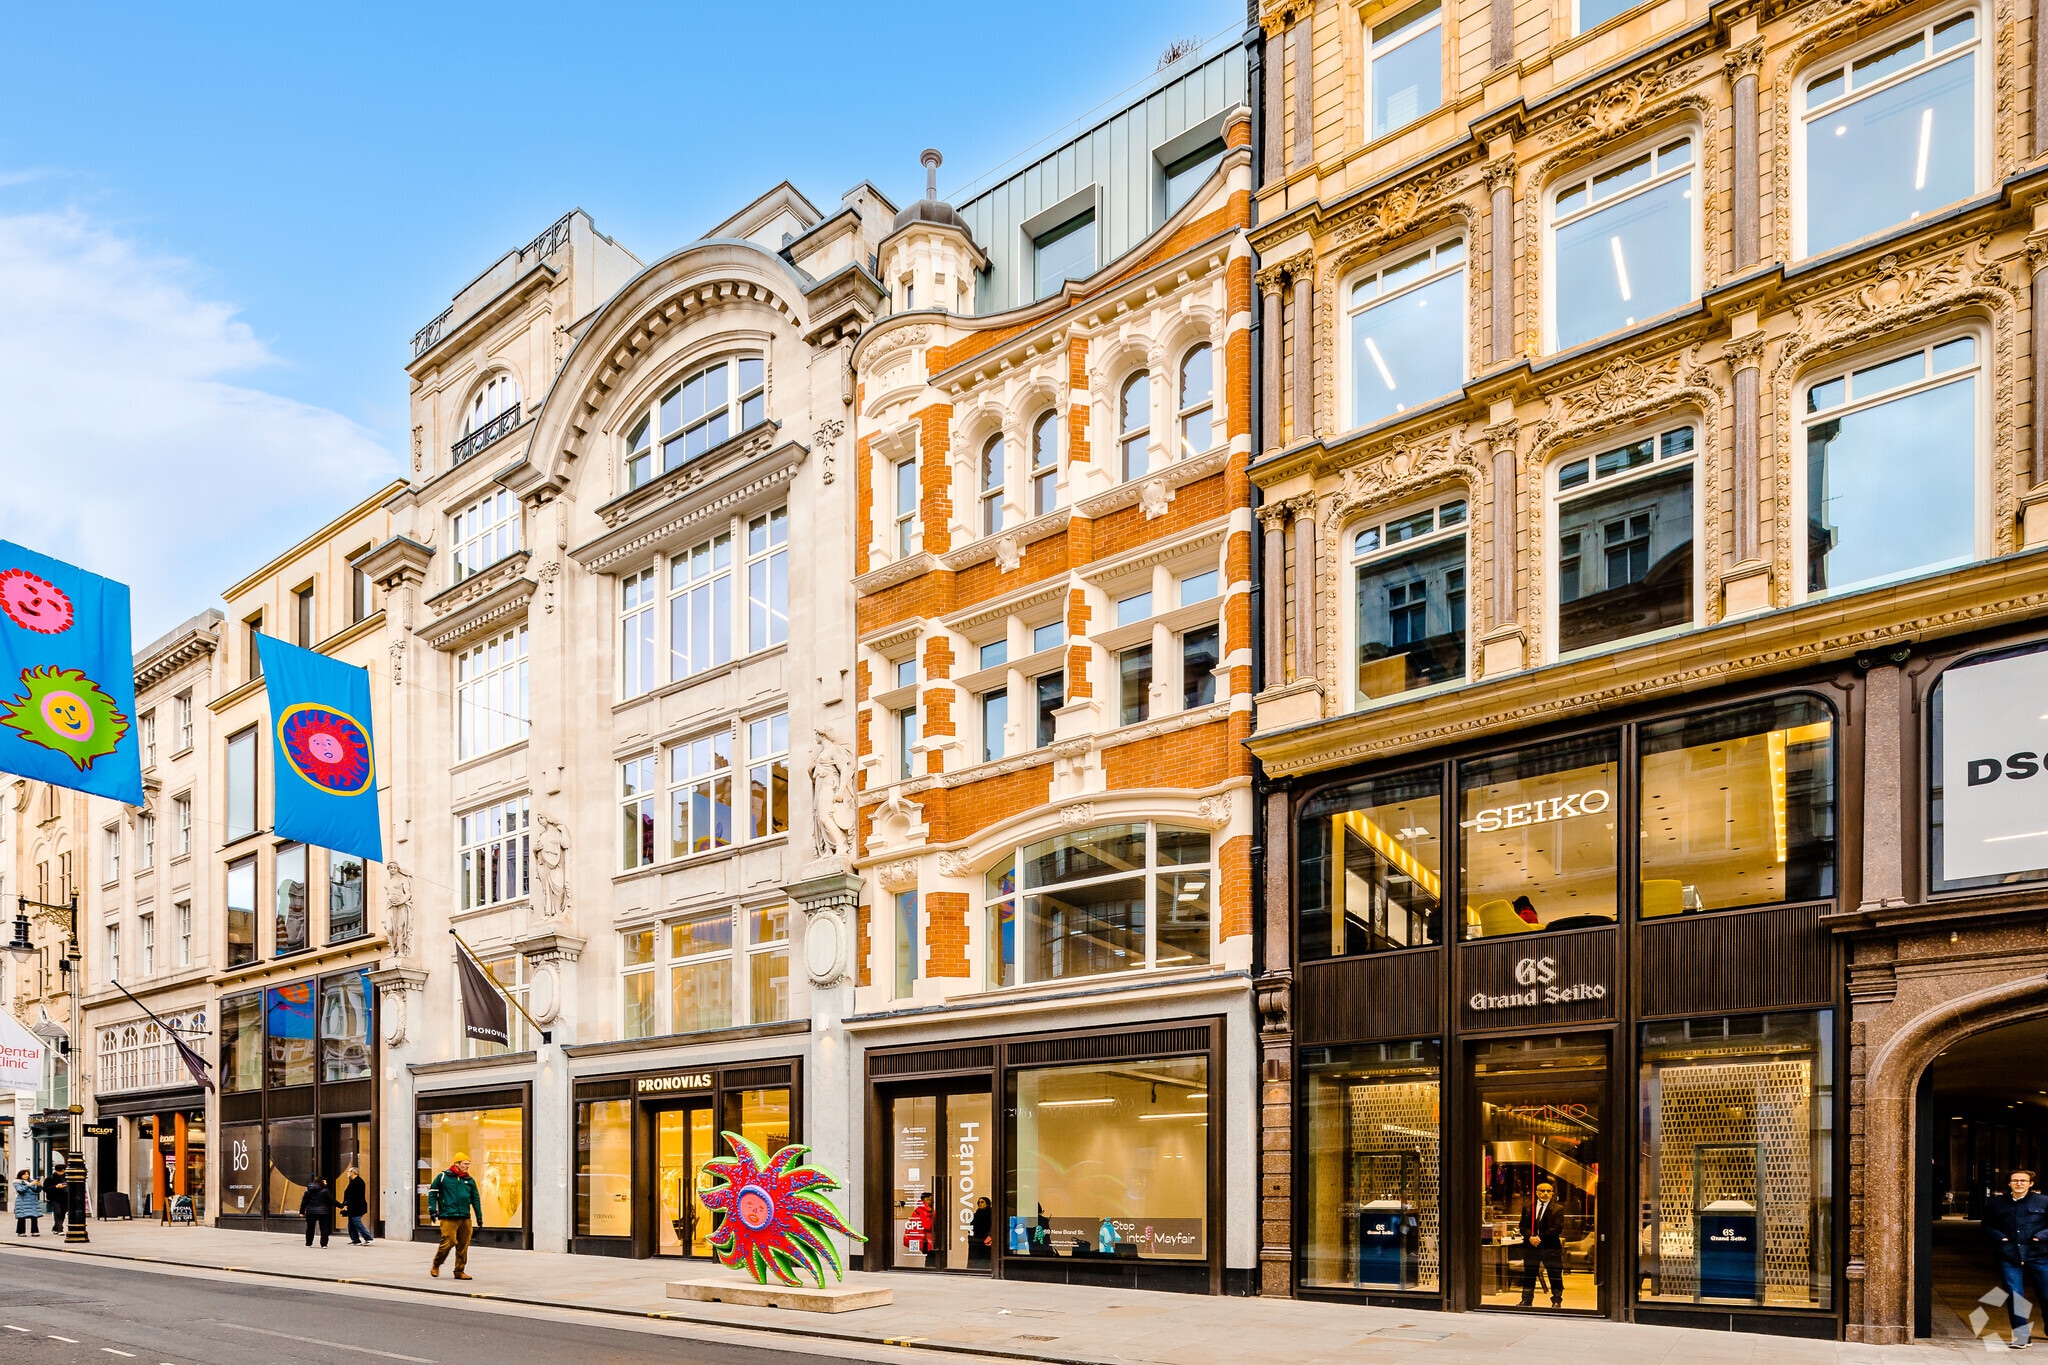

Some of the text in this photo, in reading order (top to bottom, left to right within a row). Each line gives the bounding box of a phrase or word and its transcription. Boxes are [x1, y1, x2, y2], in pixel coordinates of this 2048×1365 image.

[1967, 751, 2048, 787] DS
[1476, 789, 1610, 833] SEIKO
[1515, 956, 1556, 986] GS
[1470, 983, 1607, 1010] Grand Seiko
[638, 1074, 712, 1092] PRONOVIAS
[960, 1122, 980, 1236] Hanover
[904, 1221, 925, 1230] GPE.
[1112, 1220, 1135, 1232] Step
[1154, 1232, 1196, 1246] Mayfair
